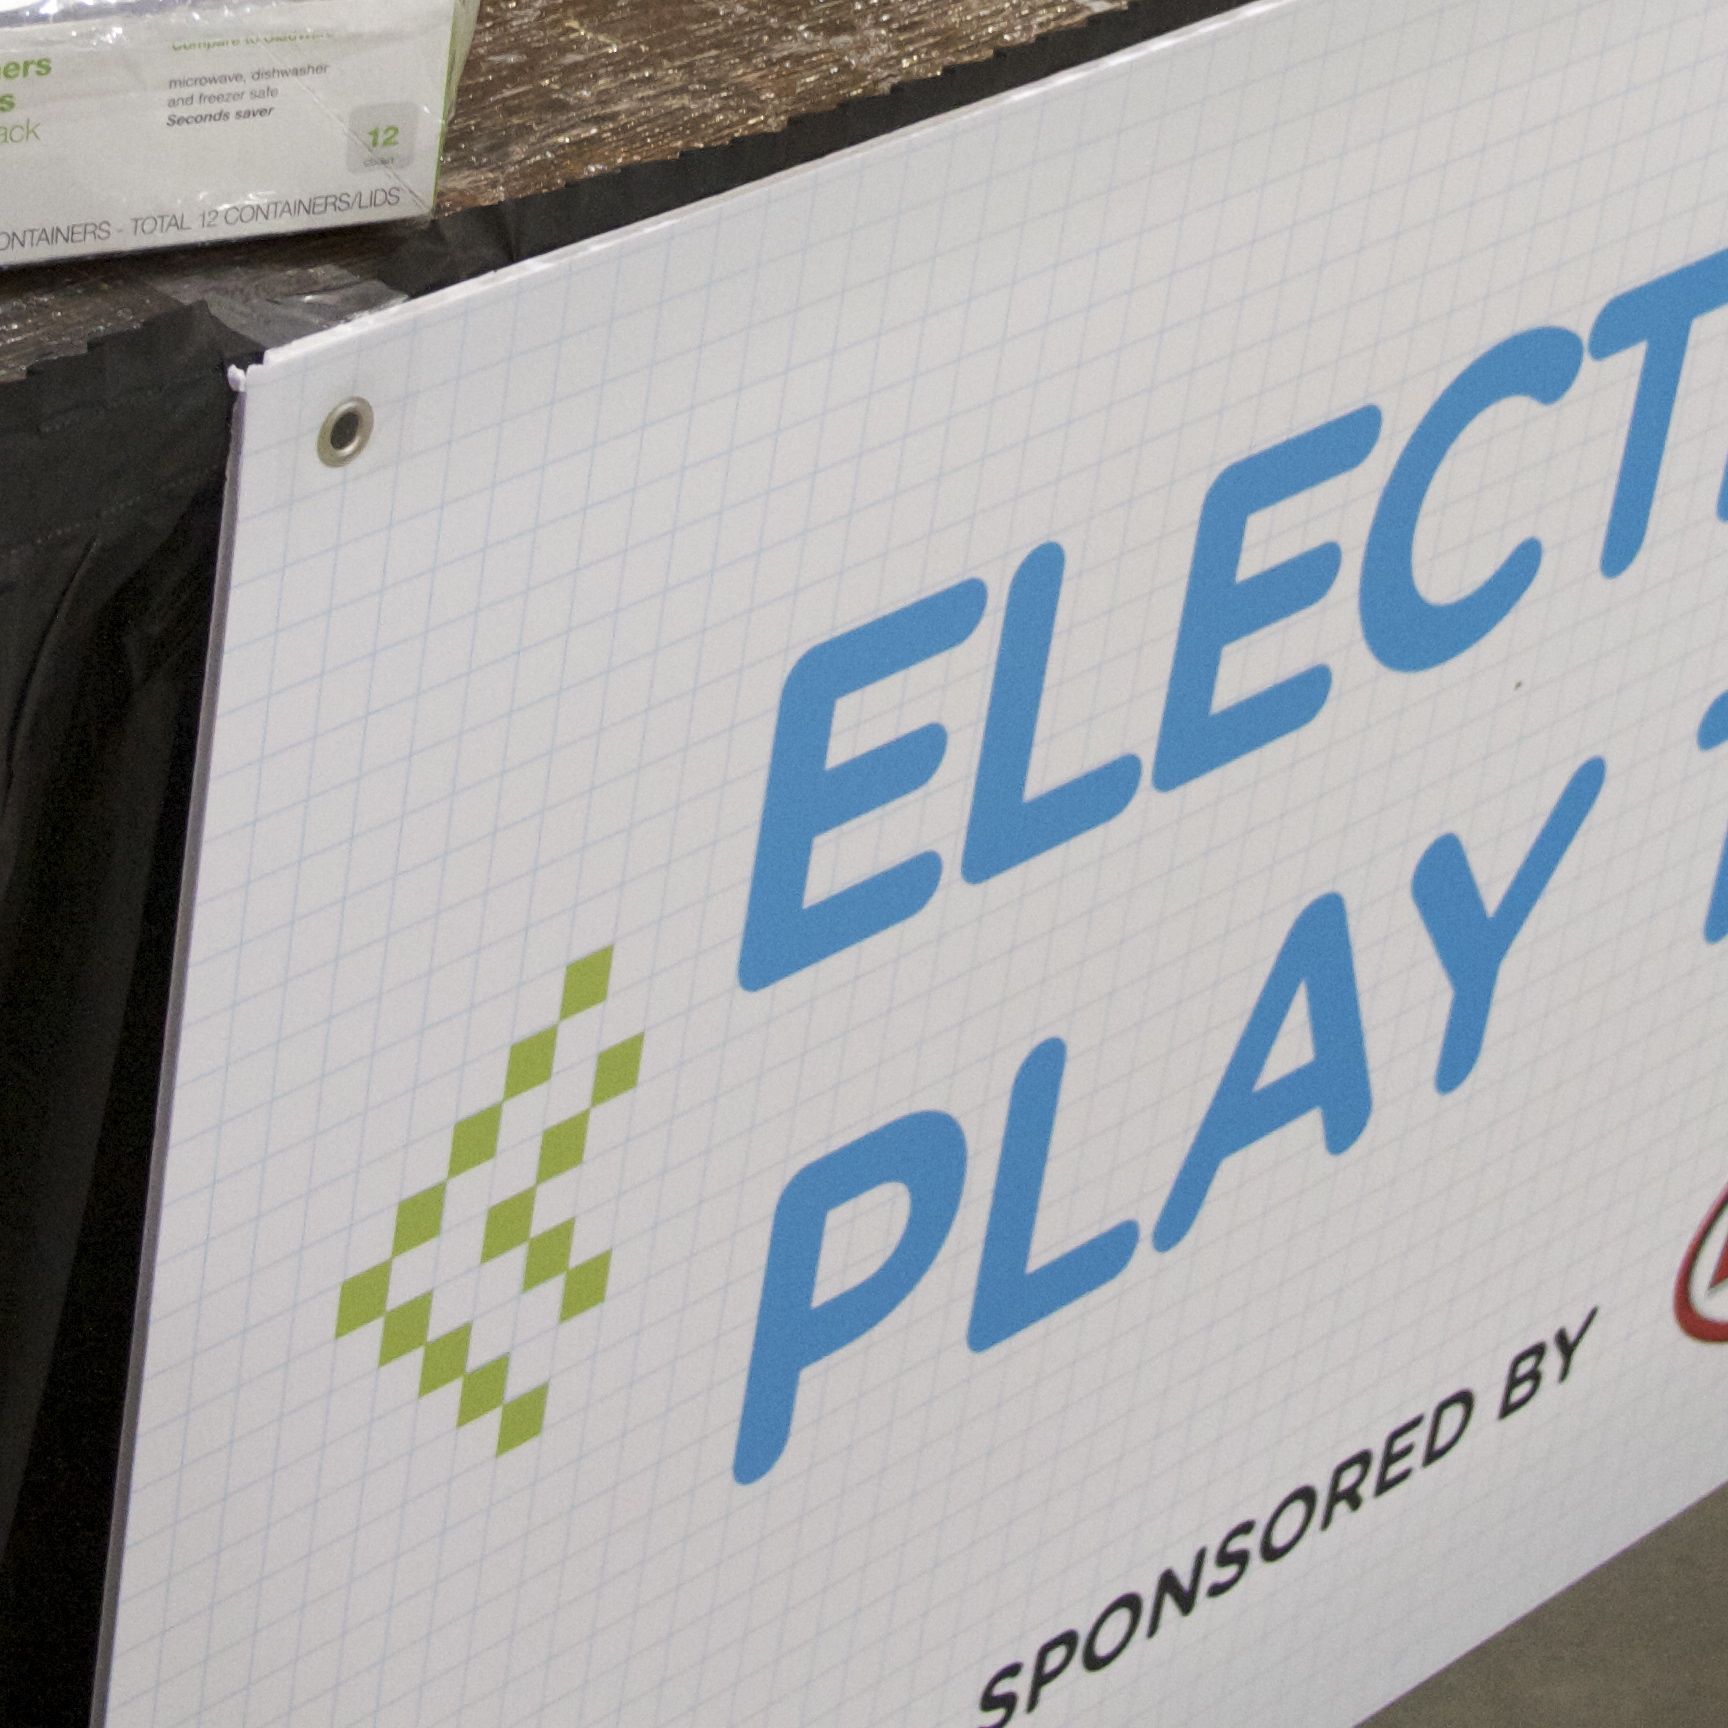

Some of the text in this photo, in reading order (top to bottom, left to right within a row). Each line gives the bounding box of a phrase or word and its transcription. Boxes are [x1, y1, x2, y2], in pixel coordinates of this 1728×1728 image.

[168, 62, 330, 90] microwave, dishwasher
[166, 84, 279, 109] and freezer safe
[165, 106, 275, 127] Seconds saver
[368, 126, 400, 148] 12
[130, 211, 192, 236] TOTAL
[199, 209, 220, 229] 12
[223, 187, 401, 226] CONTAINERS/LIDS
[732, 755, 1607, 1486] PLAY
[975, 1306, 1599, 1728] SPONSORED BY
